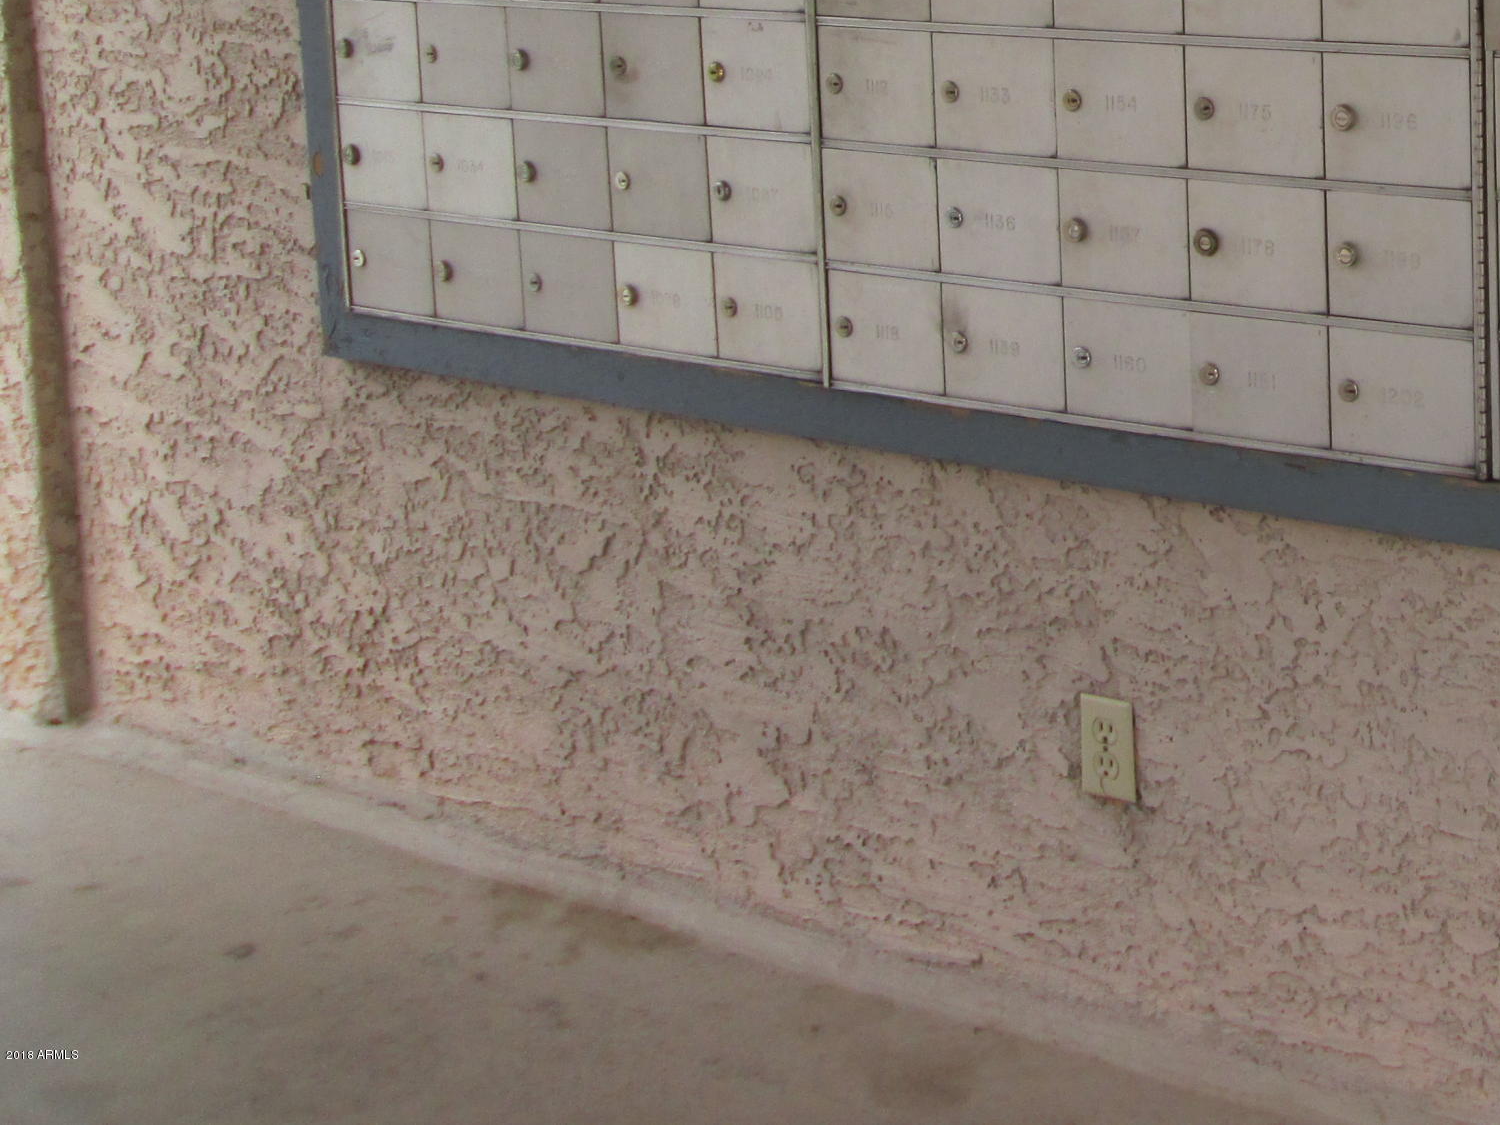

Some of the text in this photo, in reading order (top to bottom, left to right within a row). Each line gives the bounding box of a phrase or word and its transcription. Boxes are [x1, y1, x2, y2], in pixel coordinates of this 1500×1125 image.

[1105, 94, 1137, 113] 1154
[1239, 103, 1271, 122] 1175
[985, 212, 1015, 231] 1136
[1242, 237, 1274, 257] 1178
